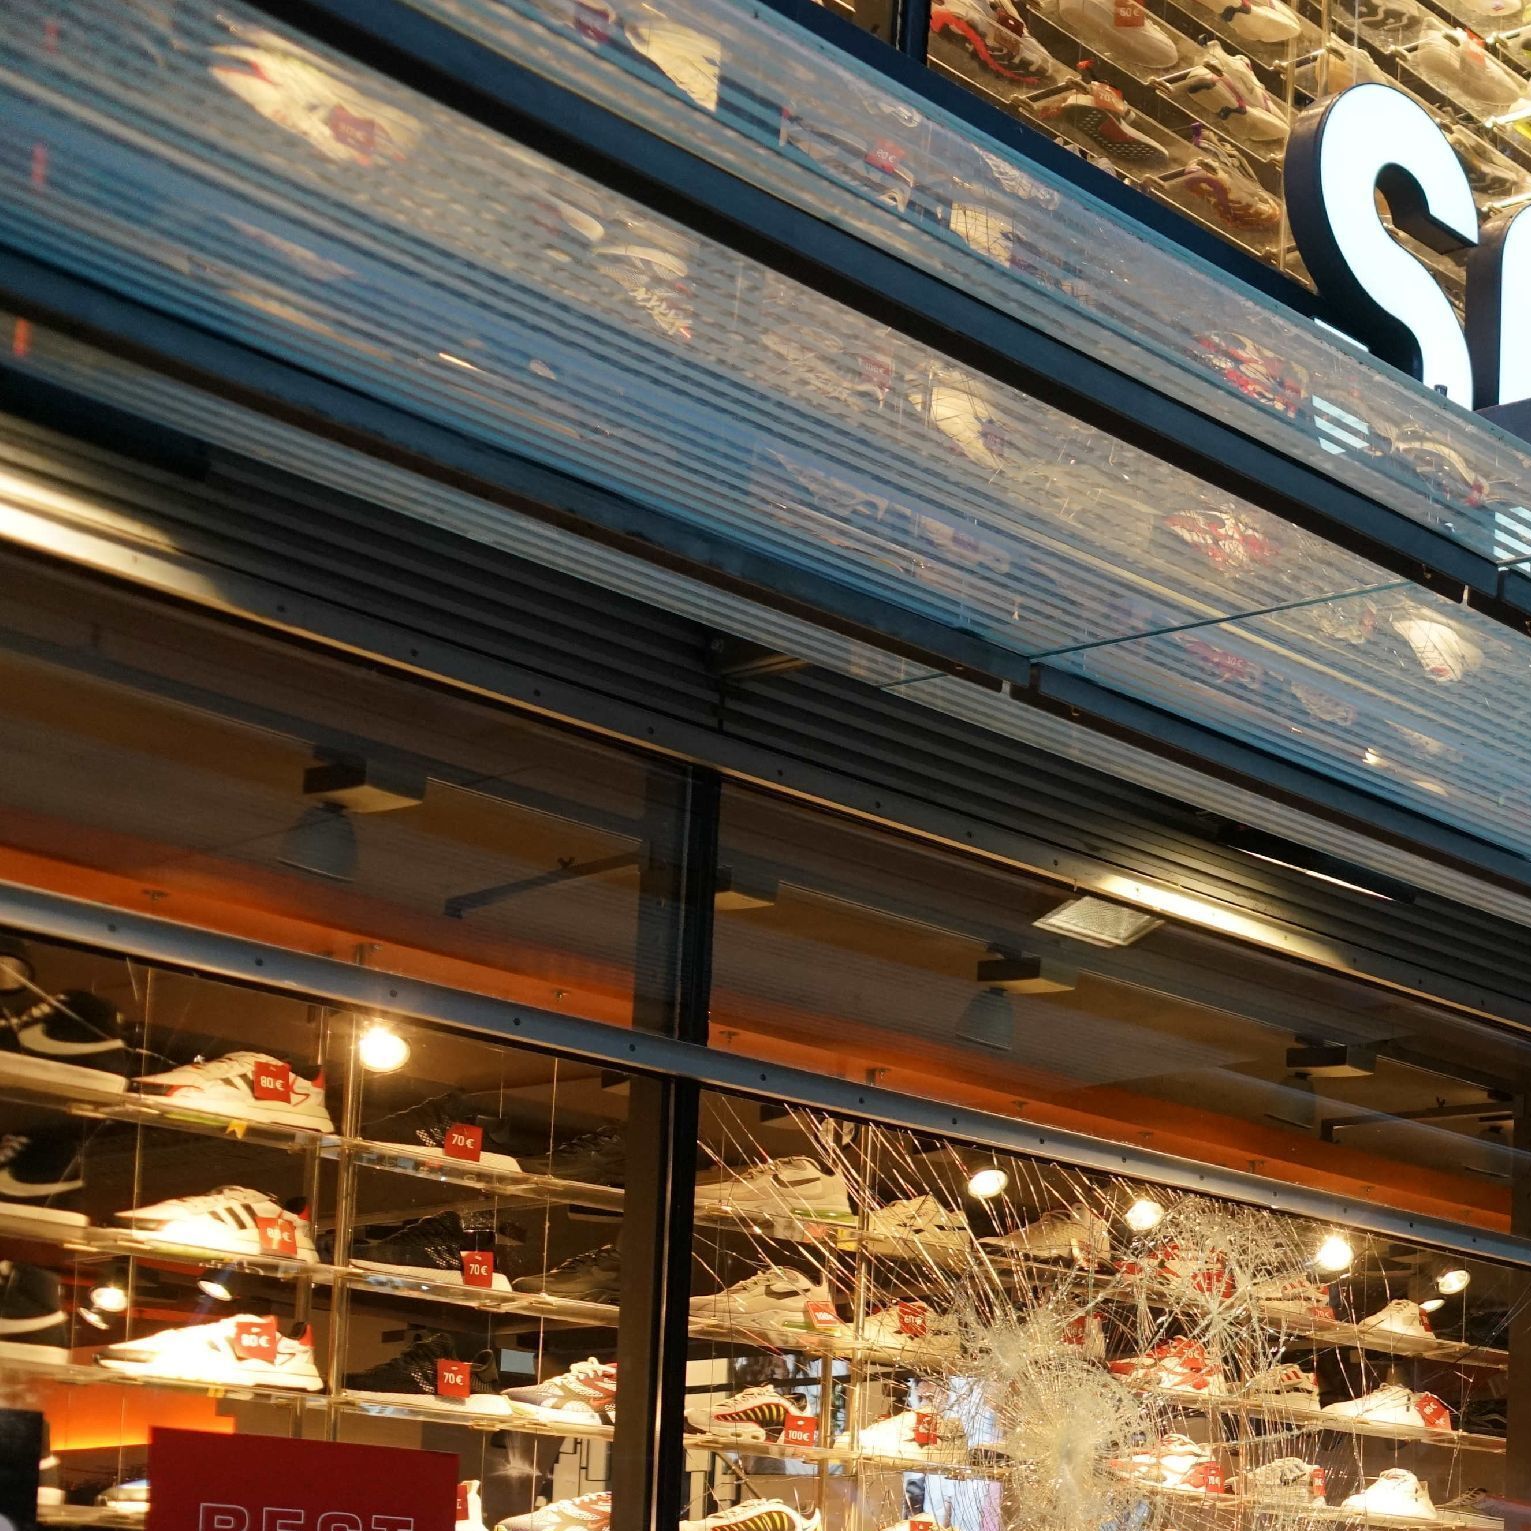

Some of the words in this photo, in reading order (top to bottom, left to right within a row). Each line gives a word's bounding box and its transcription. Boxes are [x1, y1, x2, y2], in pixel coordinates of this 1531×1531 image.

[451, 1133, 475, 1149] 70€
[469, 1263, 488, 1276] 70€
[443, 1372, 464, 1385] 70€
[788, 1430, 810, 1441] 100€
